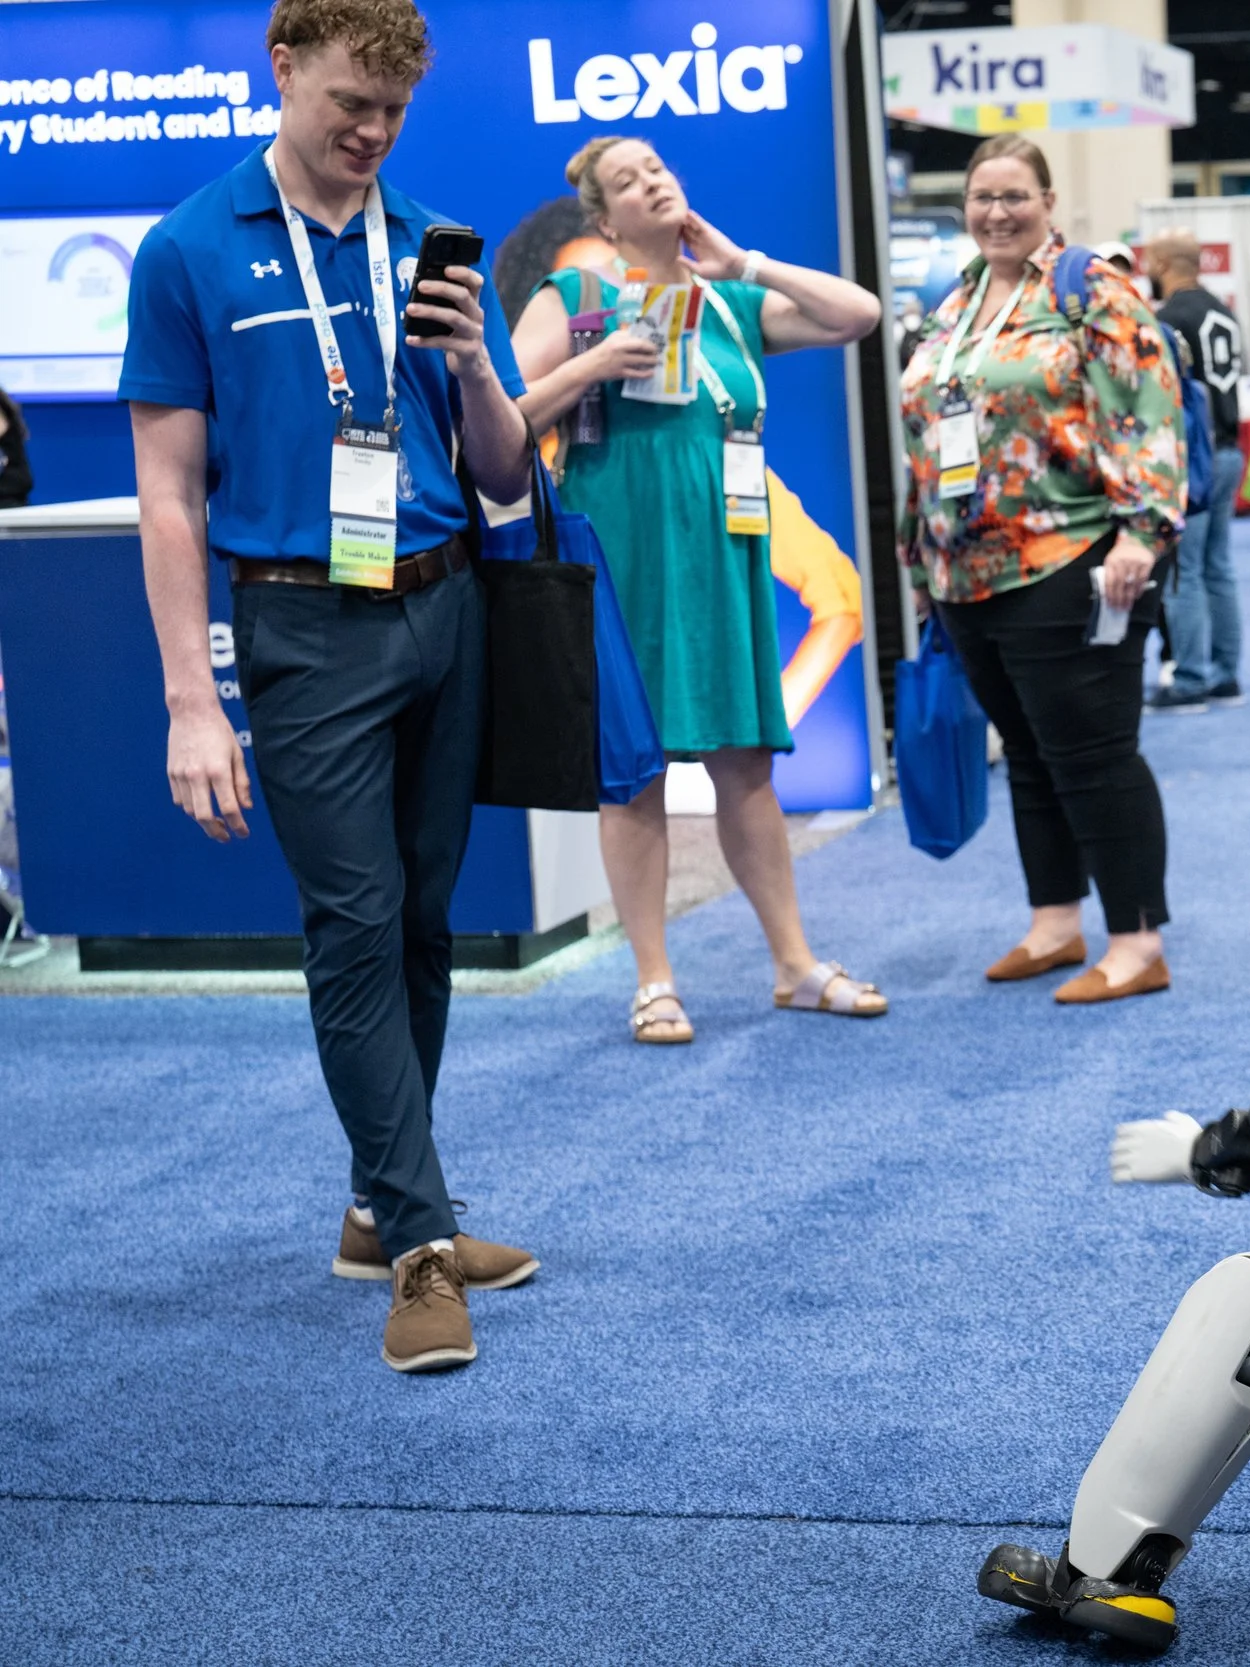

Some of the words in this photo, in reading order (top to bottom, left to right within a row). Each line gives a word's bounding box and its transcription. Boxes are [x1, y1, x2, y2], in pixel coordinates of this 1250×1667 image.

[74, 69, 109, 102] of
[111, 65, 250, 106] Reading
[528, 22, 788, 124] Lexia
[931, 42, 1045, 96] kira
[30, 110, 162, 144] Student
[163, 106, 231, 140] and
